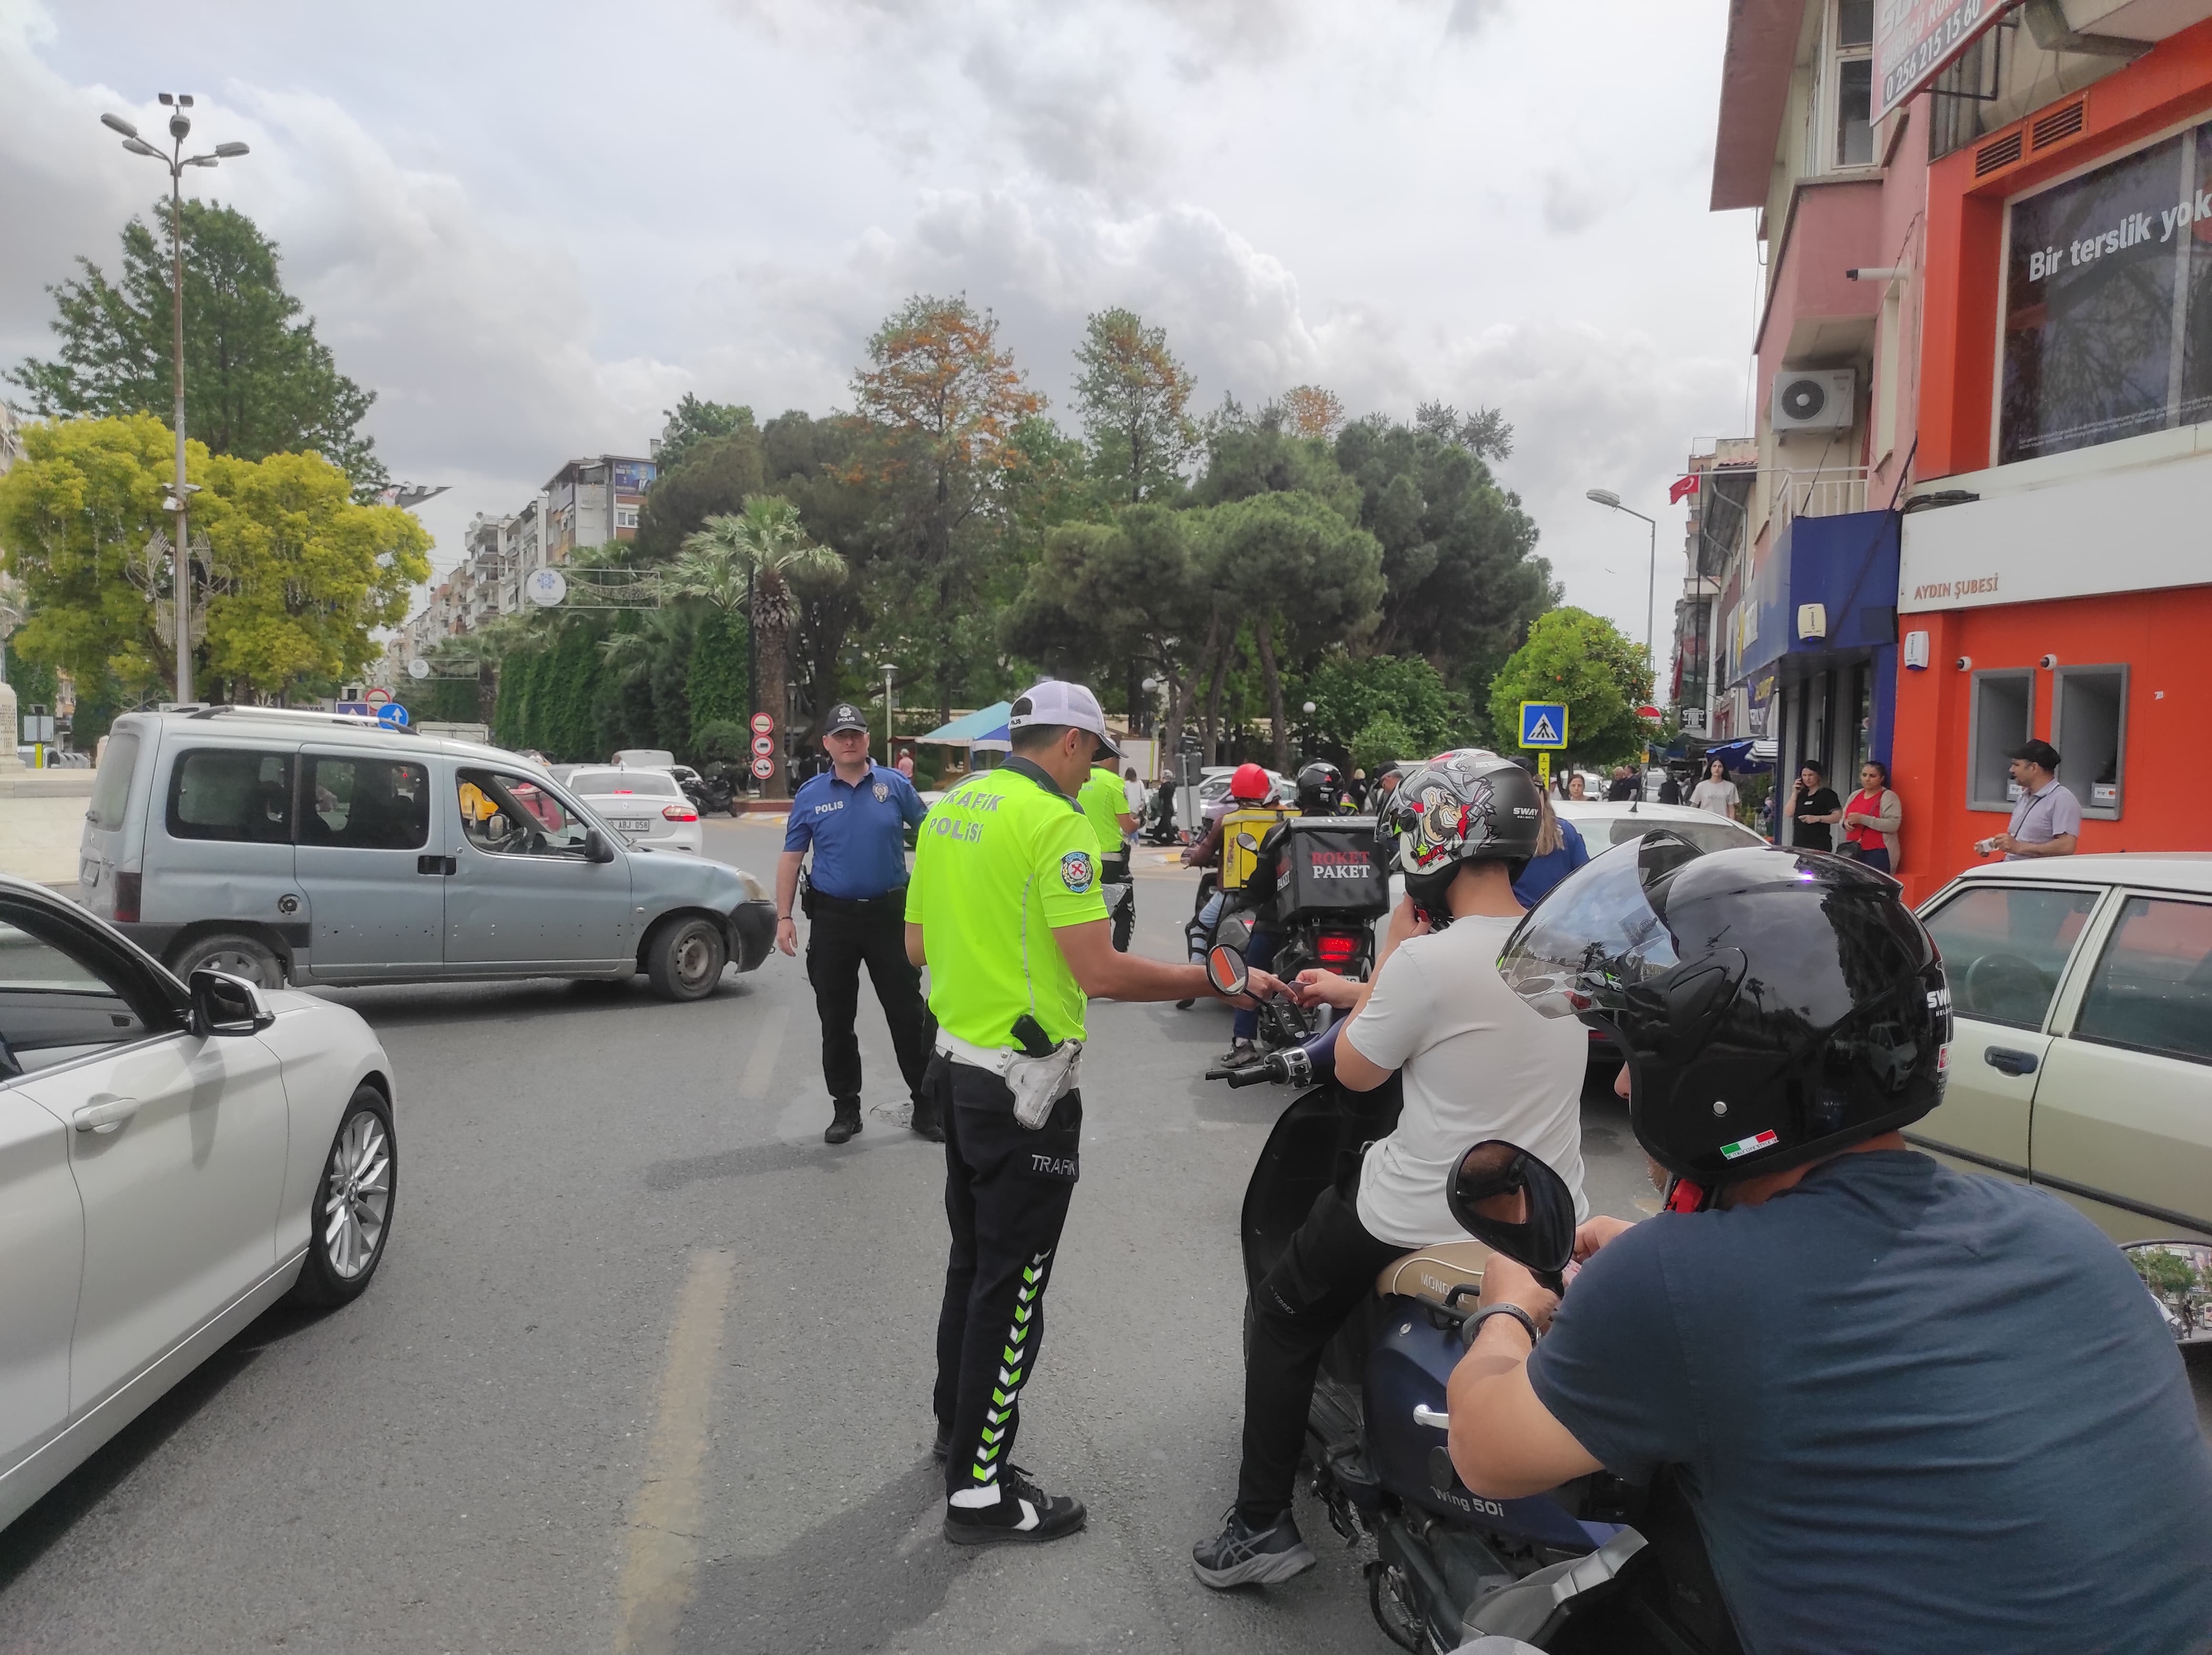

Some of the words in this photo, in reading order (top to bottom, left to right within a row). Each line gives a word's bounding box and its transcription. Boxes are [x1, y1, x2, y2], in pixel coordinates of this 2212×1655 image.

[1886, 76, 1893, 102] 0
[1895, 52, 1916, 94] 256
[1919, 26, 1941, 71] 215
[1946, 8, 1961, 44] 15
[2029, 246, 2063, 282] Bir
[2070, 212, 2152, 267] terslik
[2160, 189, 2212, 243] yok
[1914, 582, 1951, 600] AYDIN
[1954, 572, 1998, 600] ŞUBESİ
[1513, 807, 1539, 816] SWAY
[1311, 851, 1369, 865] ROKET
[1312, 865, 1370, 879] PAKET
[1926, 987, 1951, 1009] SWA
[1430, 1486, 1470, 1512] Wing
[1472, 1498, 1504, 1517] 50i
